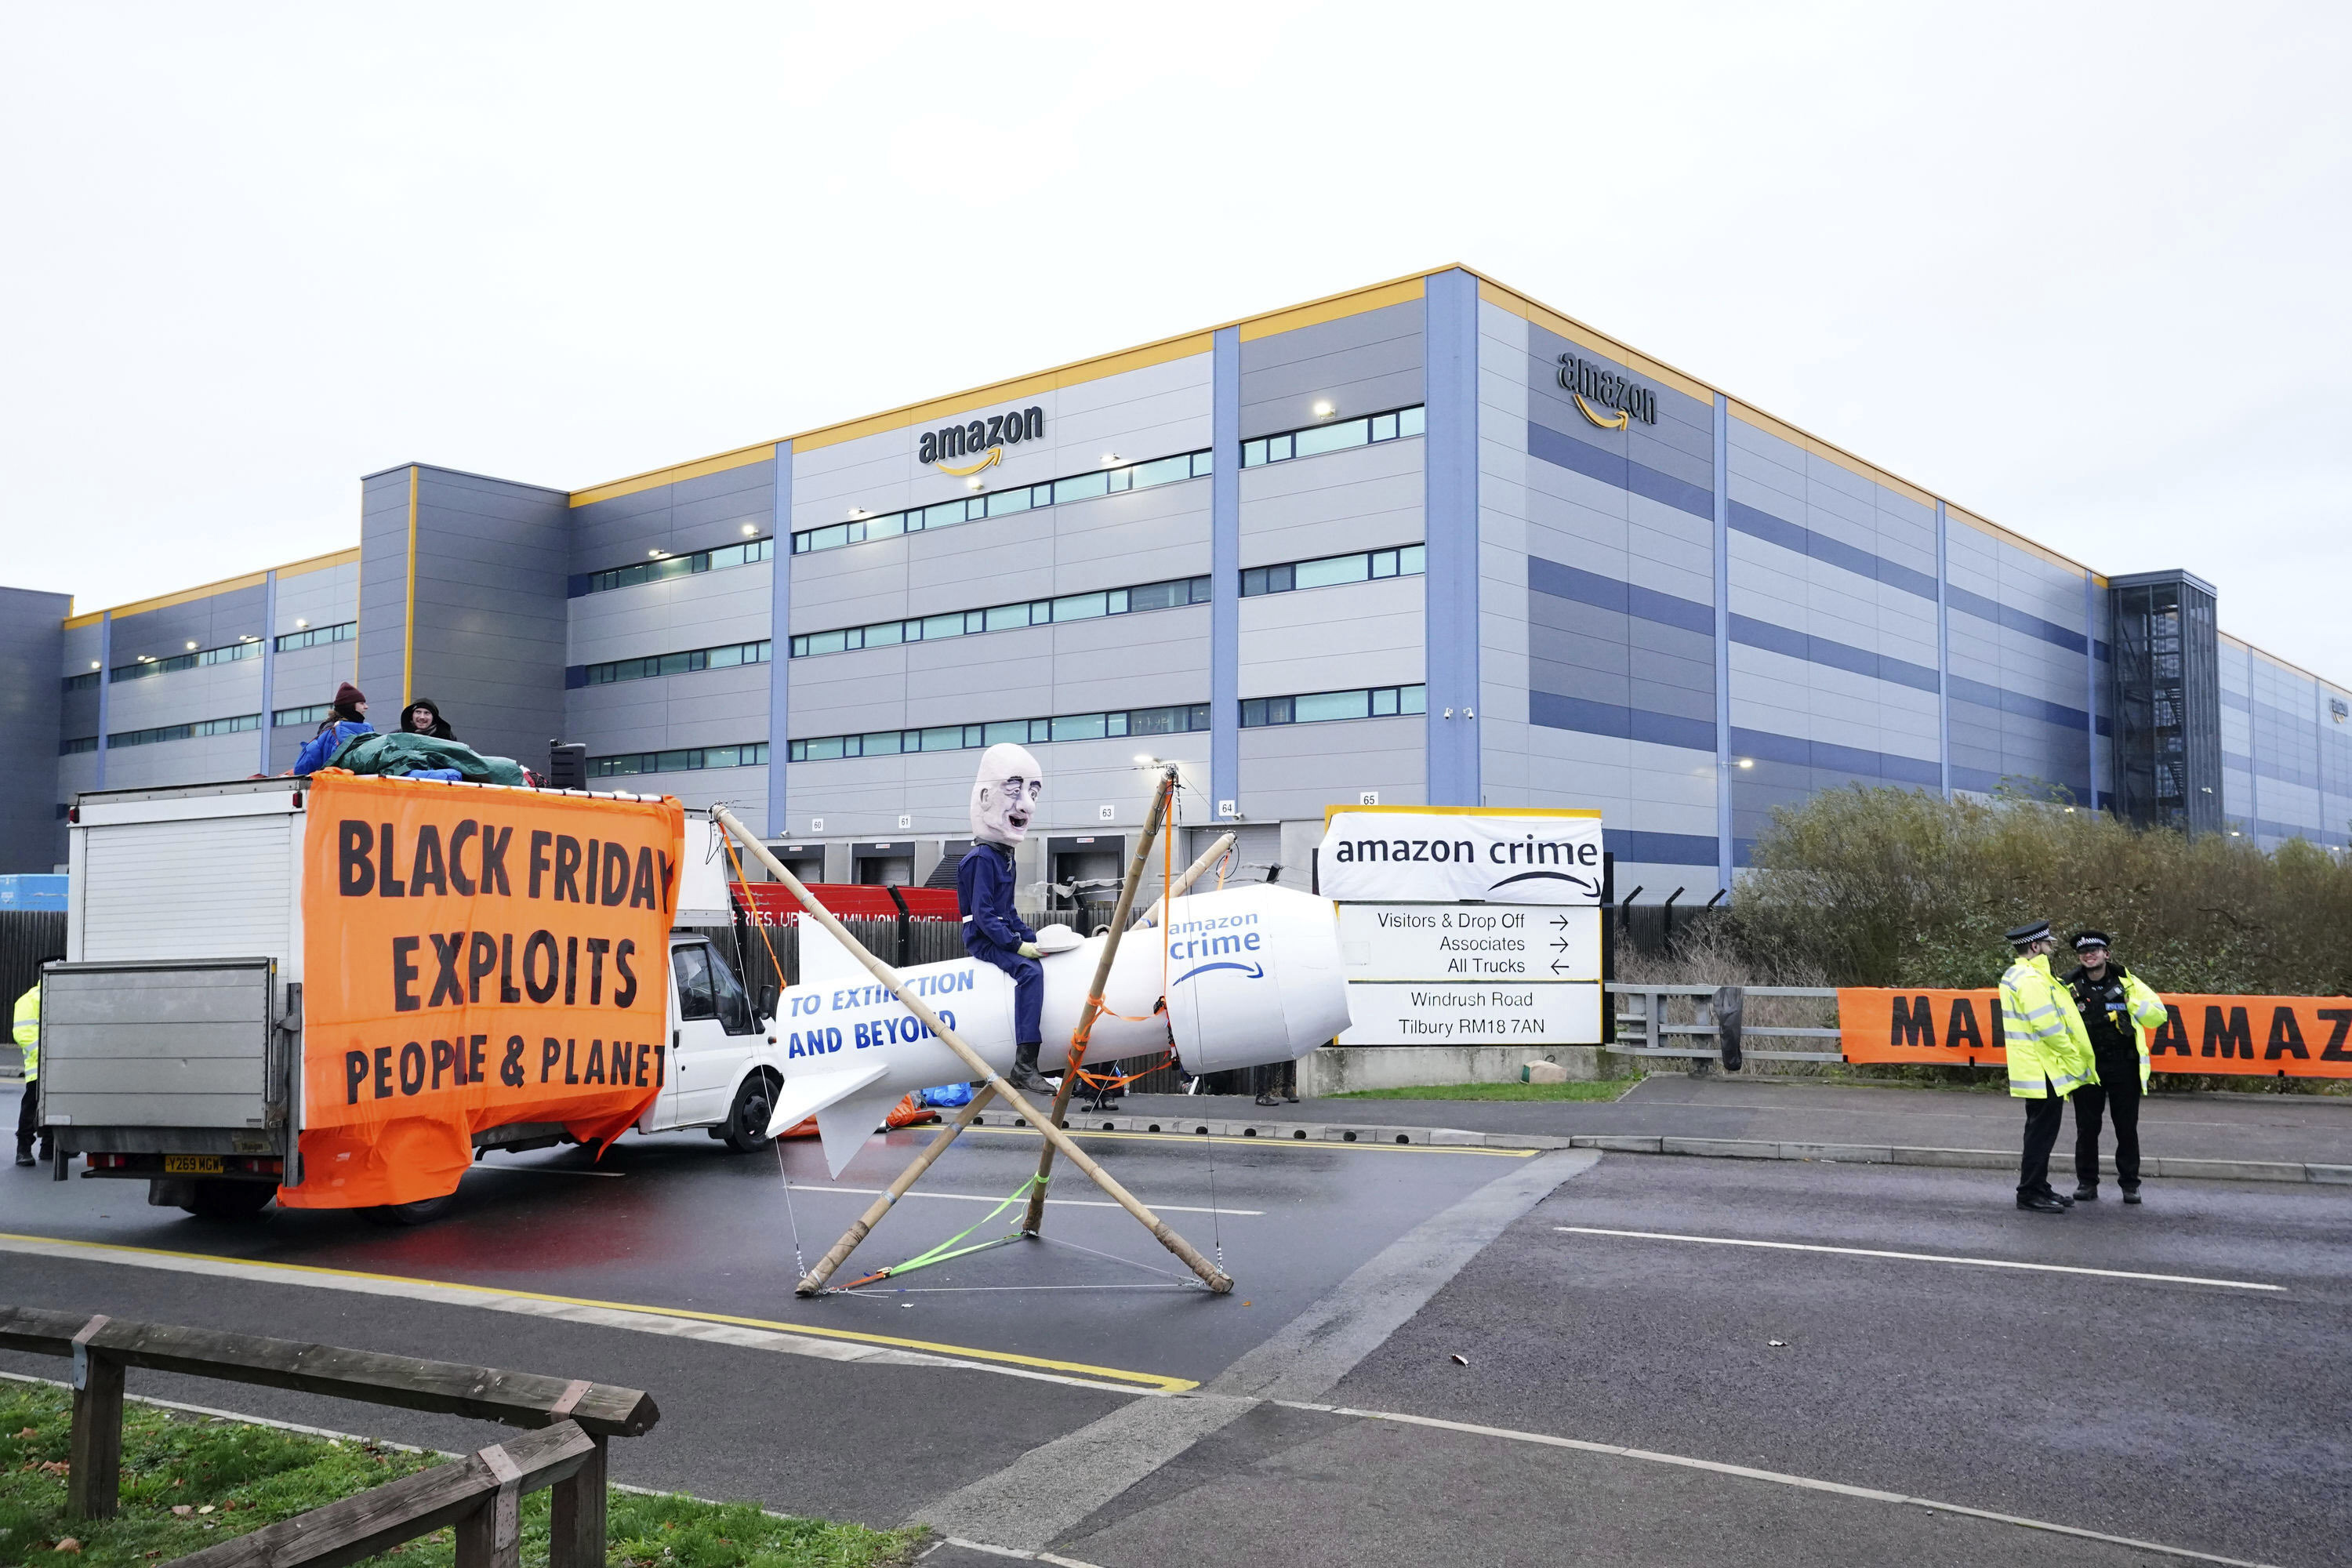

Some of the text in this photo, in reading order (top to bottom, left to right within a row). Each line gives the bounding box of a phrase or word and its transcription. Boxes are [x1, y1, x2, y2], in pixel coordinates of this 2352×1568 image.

[1559, 351, 1658, 425] amazon
[918, 405, 1044, 465] amazon
[1221, 803, 1232, 813] 64
[1363, 795, 1375, 805] 65
[900, 817, 909, 826] 61
[1102, 808, 1112, 818] 63
[813, 820, 822, 829] 60
[1336, 833, 1599, 867] amazon crime
[338, 818, 674, 915] BLACK FRIDAY
[1168, 913, 1258, 935] amazon
[1377, 913, 1525, 931] Visitors & Drop Off
[1169, 931, 1261, 960] crime
[1439, 935, 1526, 951] Associates
[392, 929, 637, 1013] EXPLOITS
[1447, 958, 1526, 974] All Trucks
[790, 993, 822, 1017] TO
[1410, 992, 1534, 1007] Windrush Road
[1398, 1018, 1545, 1039] Tilbury RM18 7AN
[789, 1026, 843, 1059] AND
[345, 1034, 666, 1106] PEOPLE & PLANET
[169, 1156, 220, 1171] Y269 MGW
